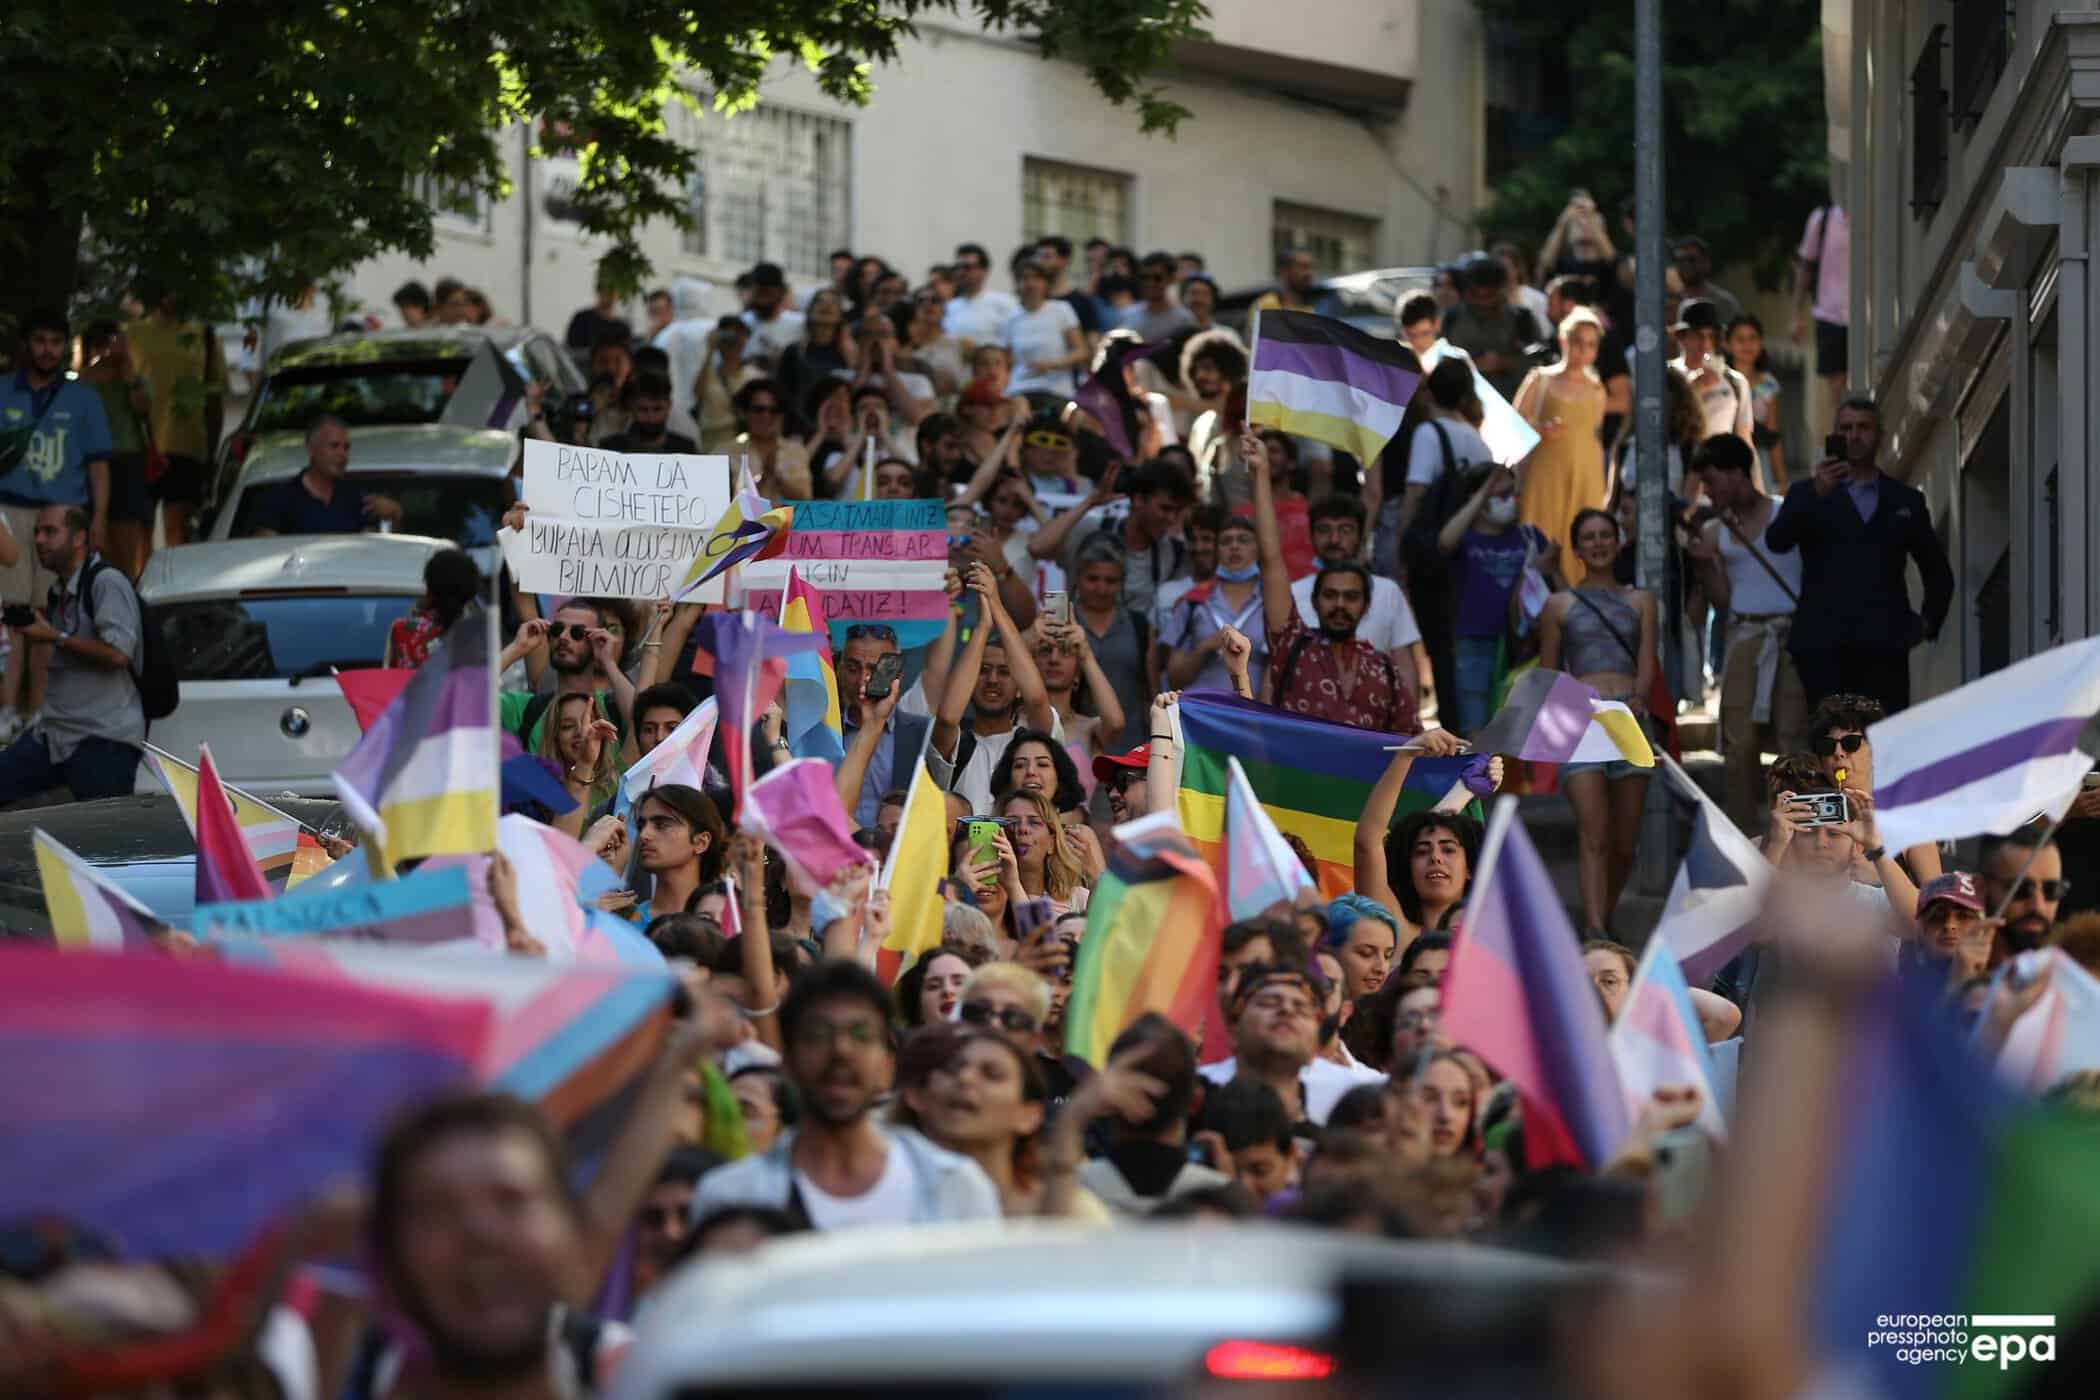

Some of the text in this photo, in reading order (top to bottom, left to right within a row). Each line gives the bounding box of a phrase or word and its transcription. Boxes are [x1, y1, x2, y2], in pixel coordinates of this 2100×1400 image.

[656, 461, 688, 489] DA
[573, 486, 706, 525] CISHETERO
[531, 520, 604, 558] BURADA
